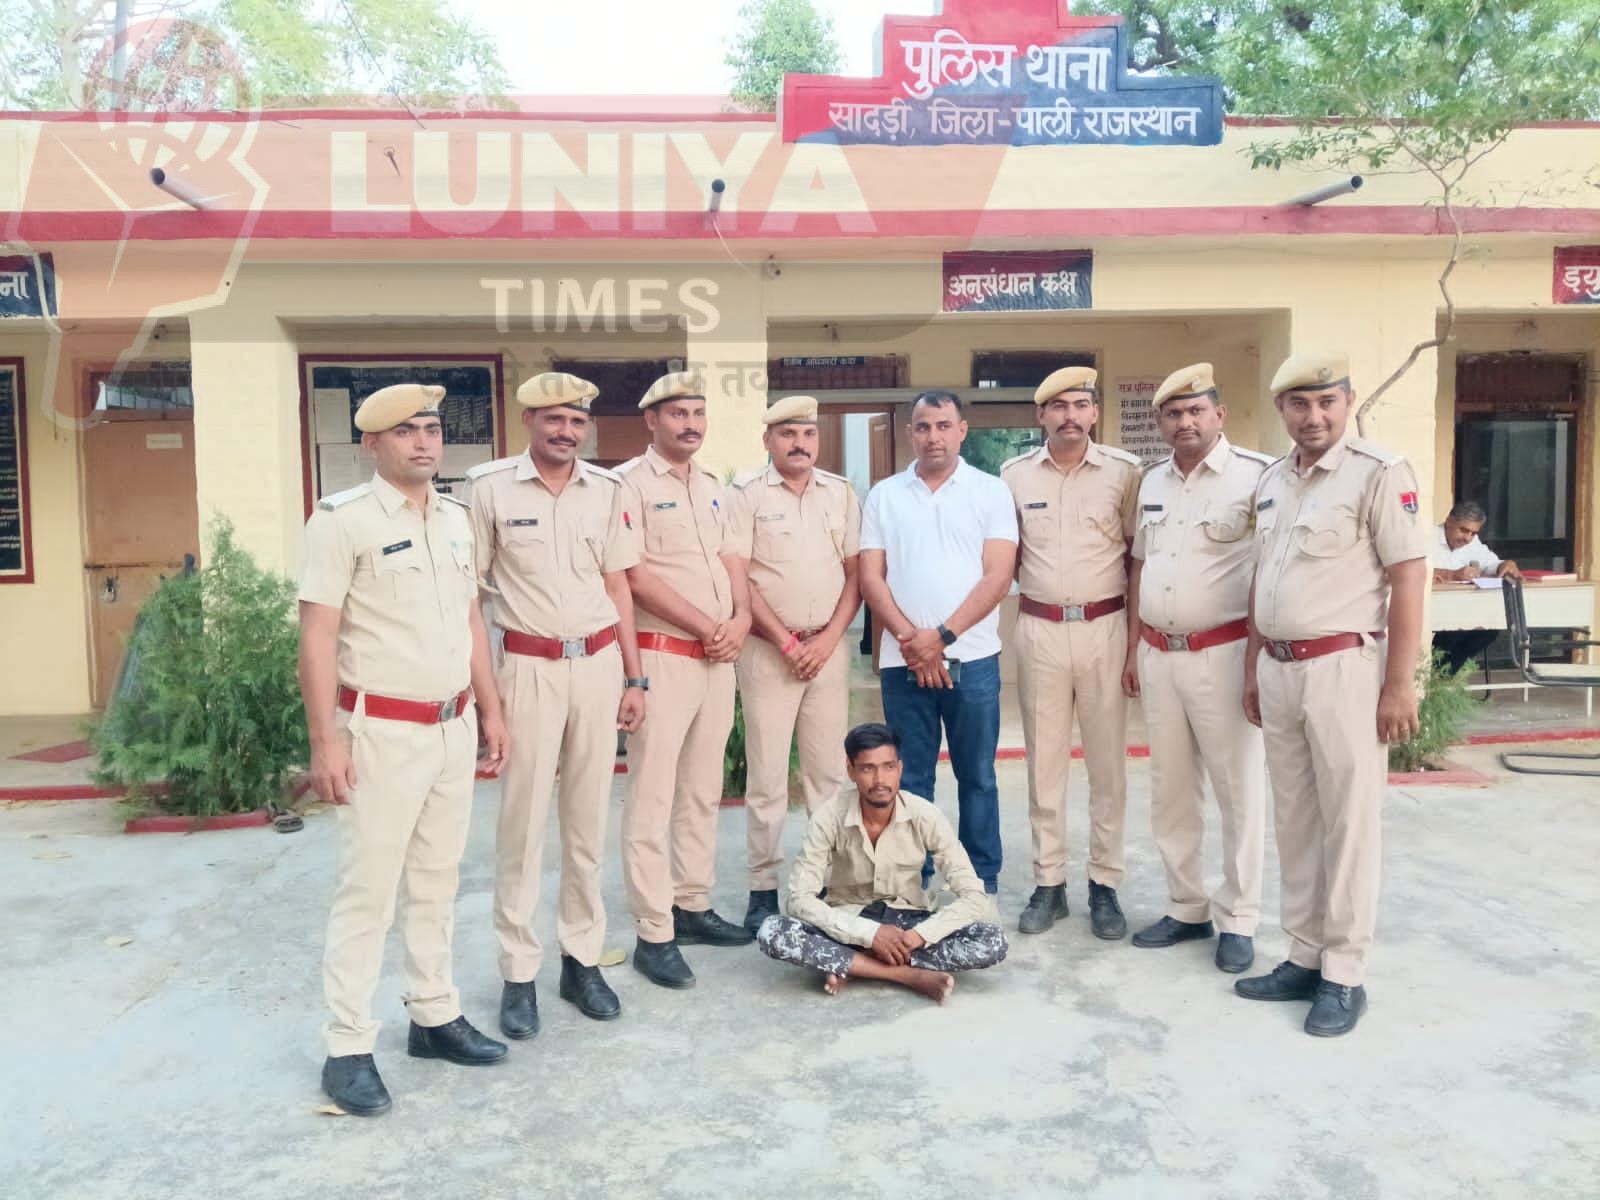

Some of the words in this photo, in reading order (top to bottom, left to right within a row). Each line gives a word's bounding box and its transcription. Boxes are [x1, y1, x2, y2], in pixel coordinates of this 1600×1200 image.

[900, 30, 1018, 99] पुलिस
[1025, 45, 1113, 92] थाना
[1083, 104, 1202, 139] राजस्थान
[948, 267, 1037, 302] अनुसंधान
[1040, 270, 1078, 297] कक्ष
